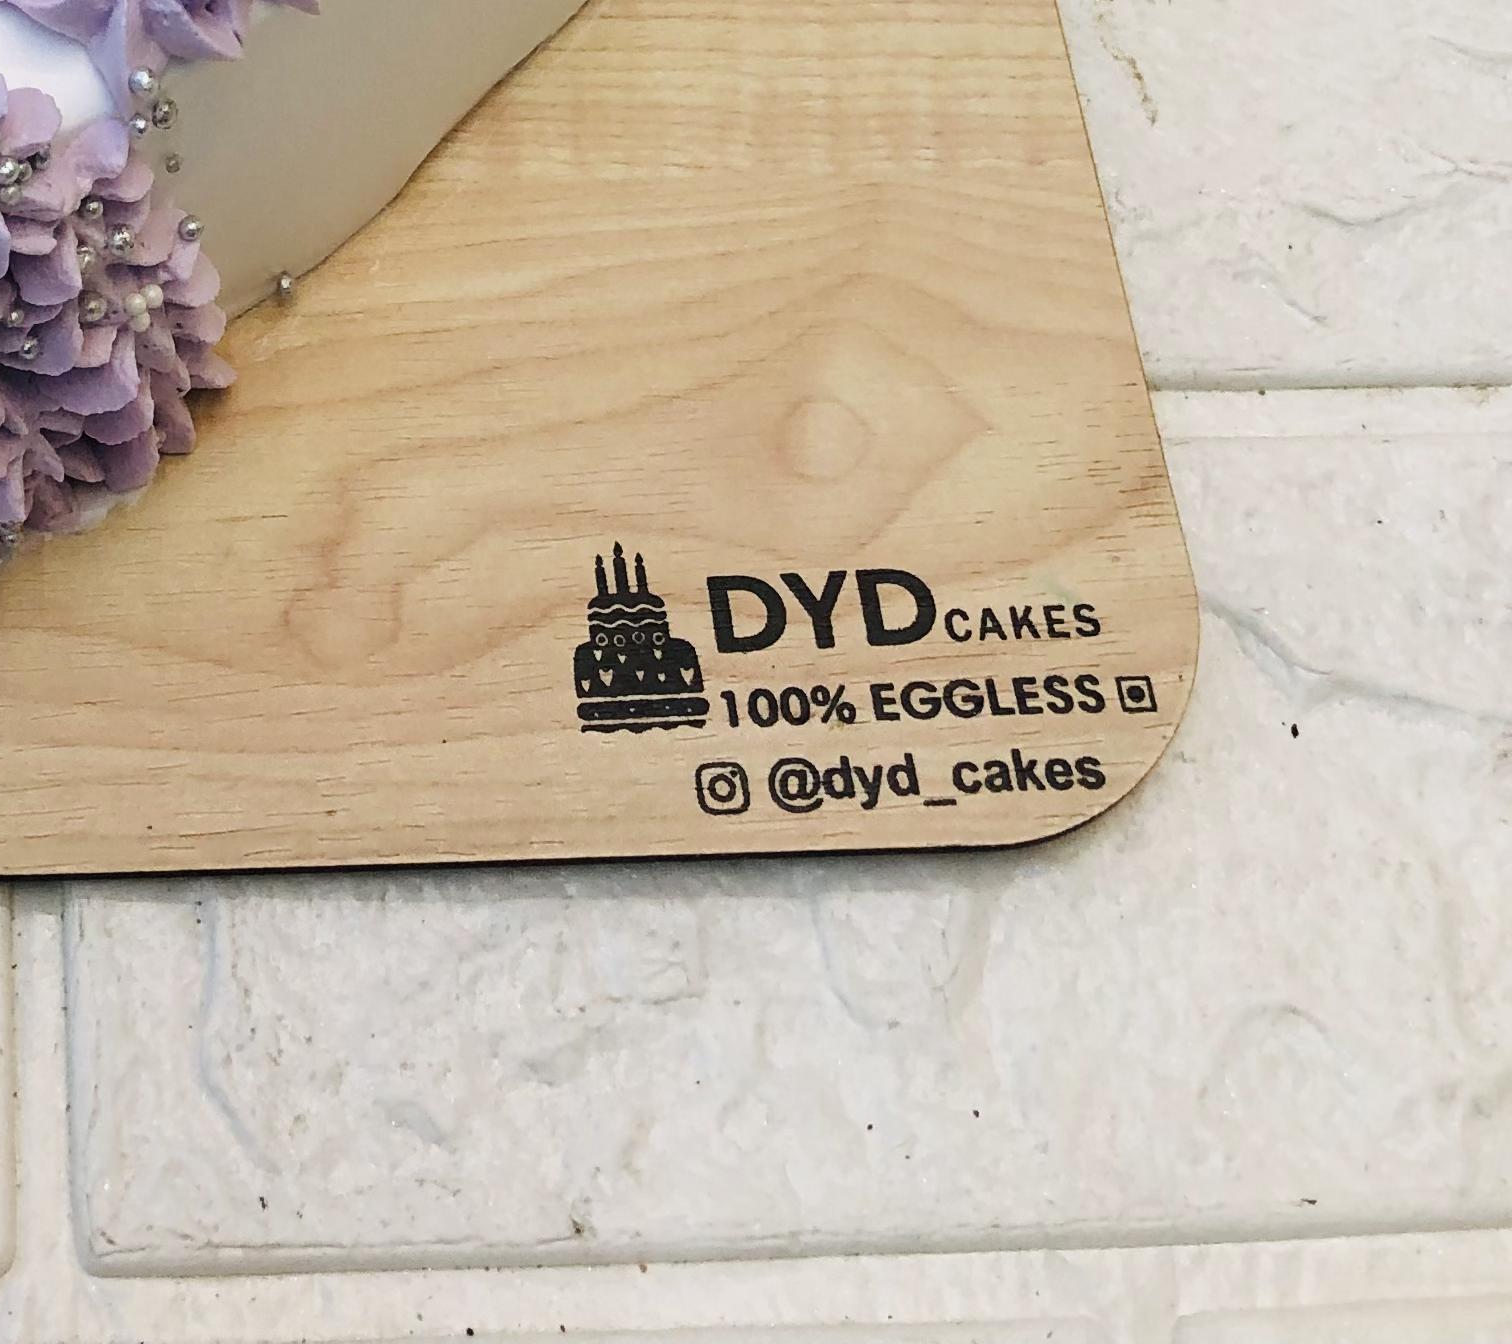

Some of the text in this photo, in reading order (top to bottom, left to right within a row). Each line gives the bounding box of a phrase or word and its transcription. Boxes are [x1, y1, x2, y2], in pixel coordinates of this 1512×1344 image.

[707, 568, 1102, 654] DYD CAKES
[720, 674, 1106, 728] 100% EGGLESS
[768, 749, 1107, 814] @dyd_cakes
